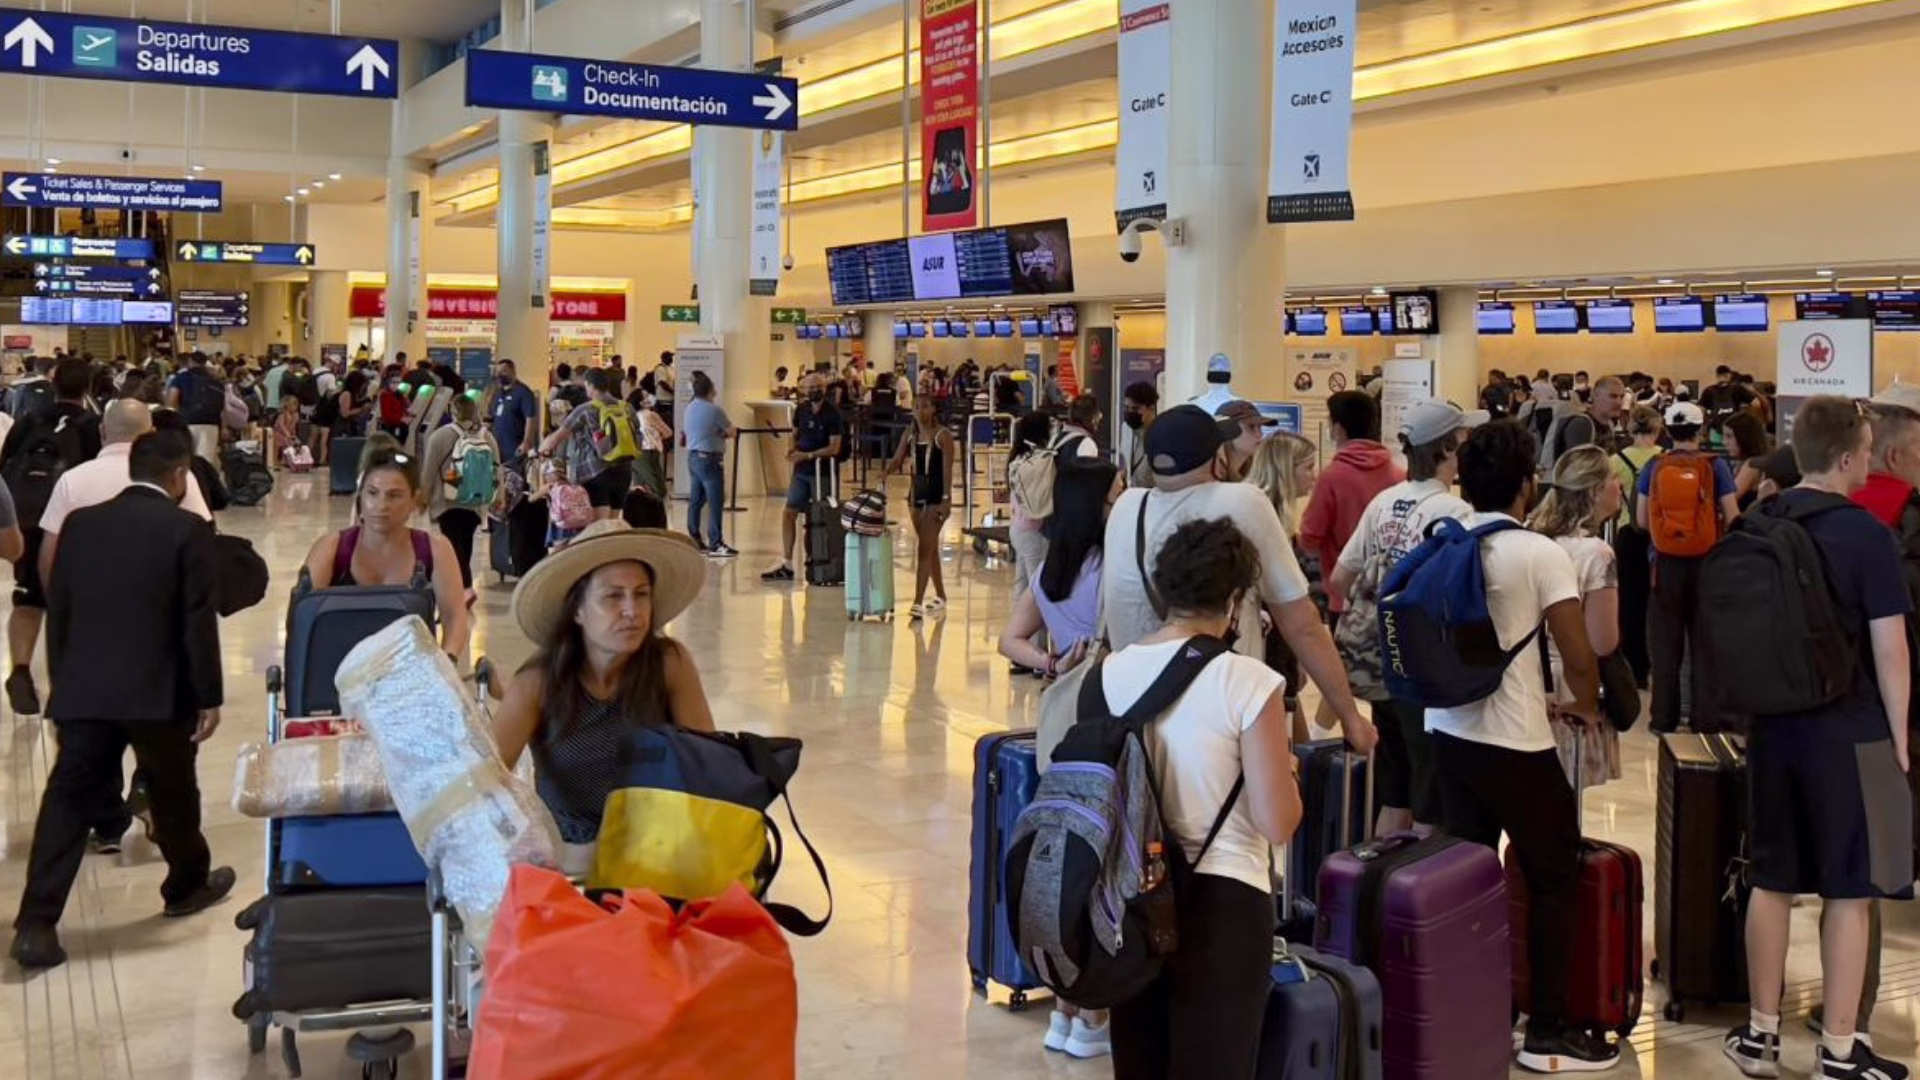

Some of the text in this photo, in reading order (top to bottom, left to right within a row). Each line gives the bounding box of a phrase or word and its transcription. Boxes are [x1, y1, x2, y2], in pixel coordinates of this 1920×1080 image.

[137, 25, 250, 53] Departures
[136, 49, 220, 76] Salidas
[583, 63, 660, 88] Check-In
[583, 86, 728, 115] Documentación
[1131, 97, 1156, 112] Gate
[1290, 92, 1318, 107] Gate
[42, 176, 186, 194] Ticket Sales & Passenger Services
[42, 190, 219, 209] Venta de boletos y servicios al pasajero
[922, 256, 946, 272] ASUR
